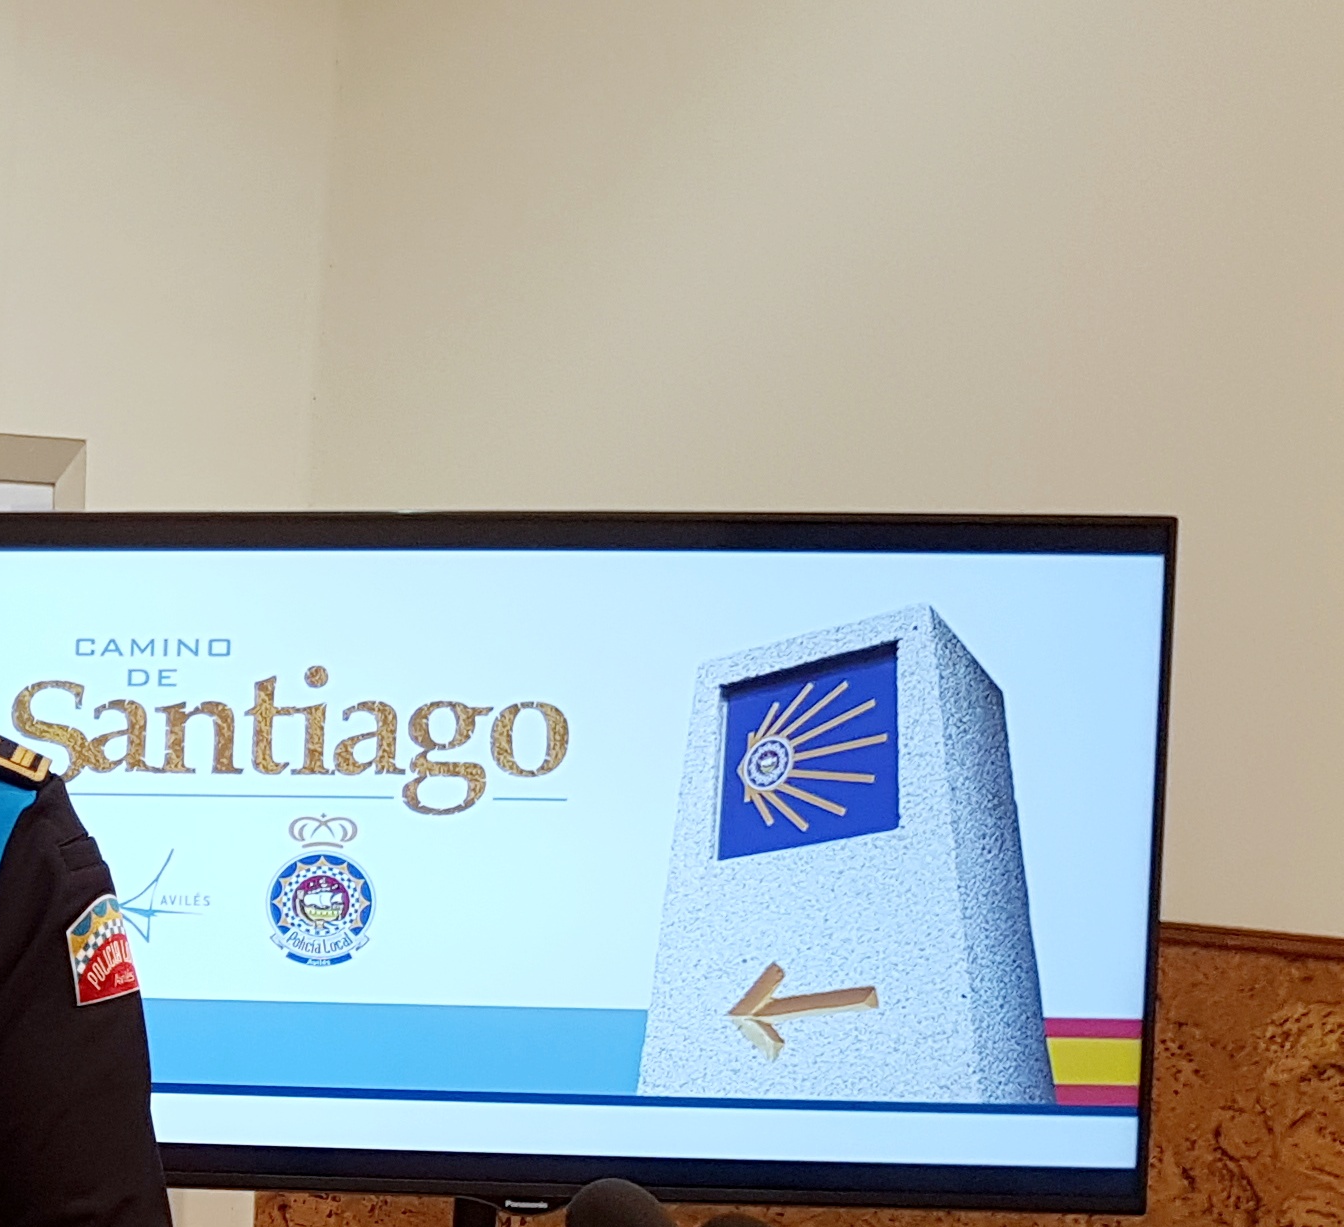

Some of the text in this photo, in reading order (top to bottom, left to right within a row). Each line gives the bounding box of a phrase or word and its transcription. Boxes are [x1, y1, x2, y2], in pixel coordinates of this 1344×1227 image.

[75, 638, 232, 658] CAMINO
[127, 668, 178, 687] DE
[11, 665, 569, 816] Santiago
[160, 892, 211, 907] AVILÉS
[286, 931, 354, 954] Policía Local
